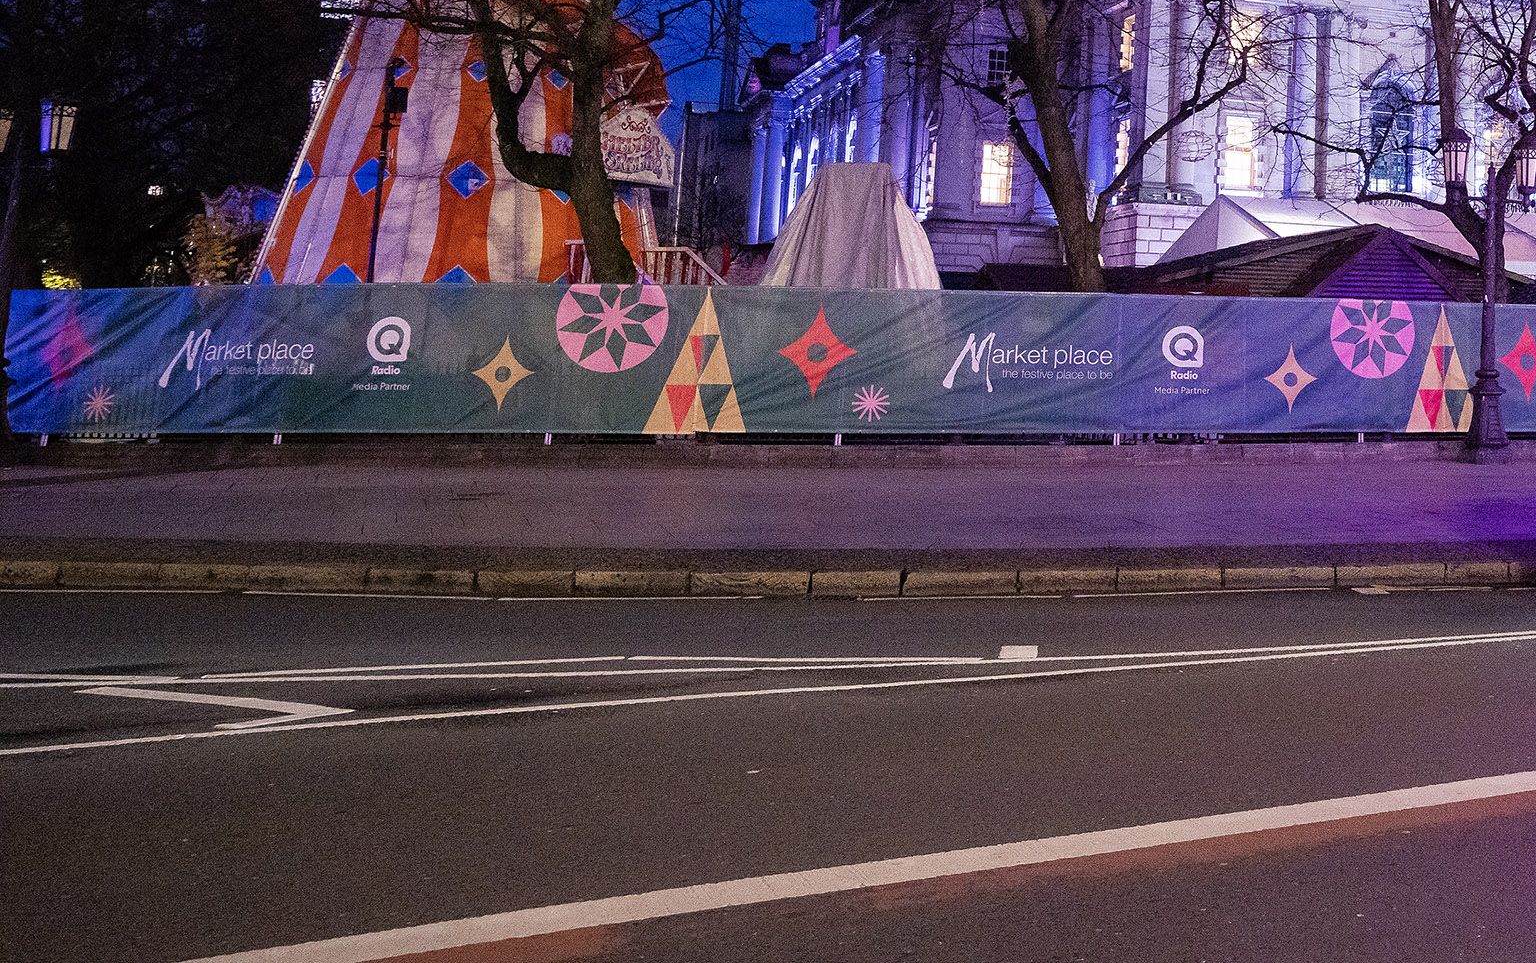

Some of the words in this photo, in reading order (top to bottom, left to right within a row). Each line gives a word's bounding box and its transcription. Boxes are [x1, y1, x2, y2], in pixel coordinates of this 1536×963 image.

[372, 321, 404, 358] Q
[1166, 330, 1201, 363] Q
[158, 328, 252, 391] Market
[257, 339, 315, 364] place
[942, 332, 1049, 393] Market
[1054, 344, 1113, 369] place
[371, 365, 401, 375] Radio
[1002, 369, 1019, 379] the
[1021, 369, 1054, 380] festive
[1056, 369, 1085, 381] place
[1087, 370, 1098, 380] to
[1100, 369, 1113, 380] be
[1170, 370, 1199, 380] Radio
[380, 382, 411, 391] Partner
[1154, 386, 1179, 395] Media
[1180, 386, 1210, 395] Partner
